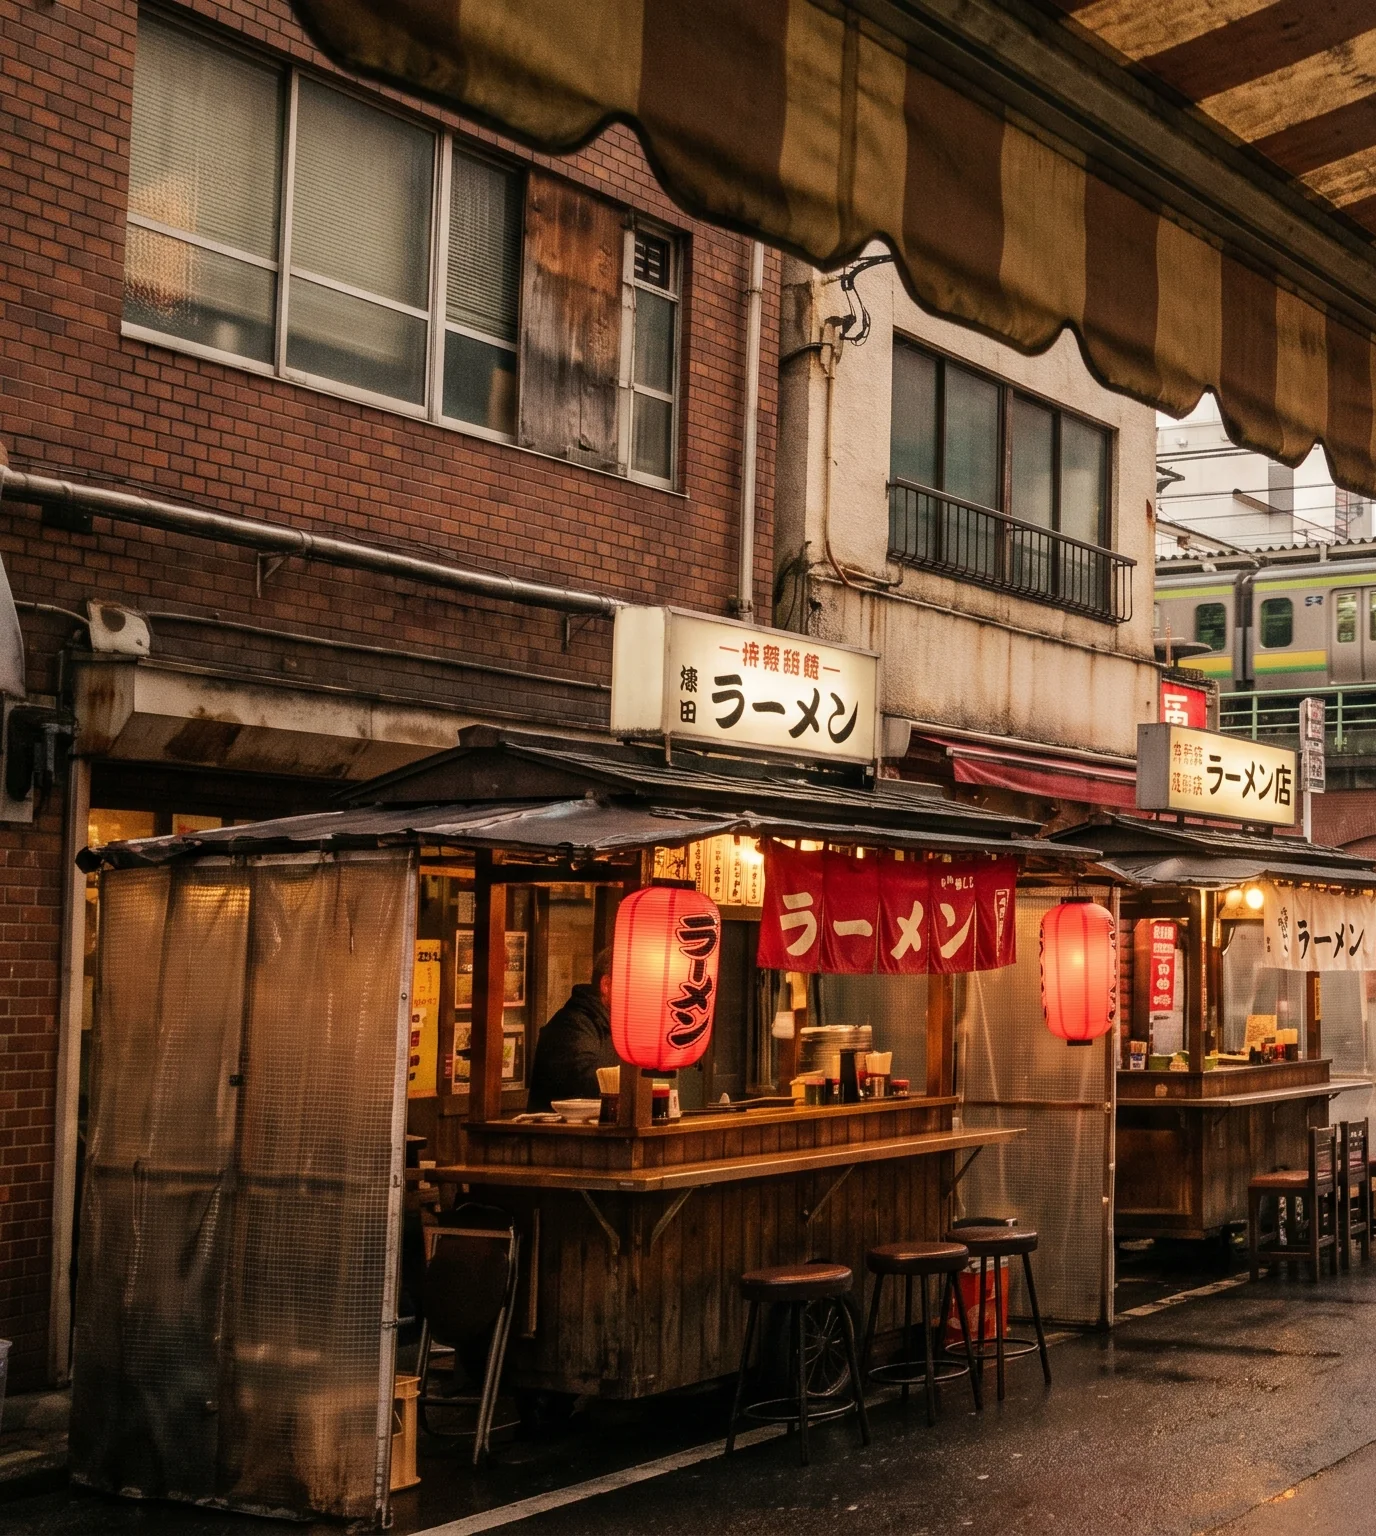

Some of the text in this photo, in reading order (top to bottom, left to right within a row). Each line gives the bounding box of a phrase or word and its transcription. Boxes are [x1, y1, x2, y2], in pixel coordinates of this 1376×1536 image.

[711, 674, 859, 743] ラーメン
[1206, 754, 1292, 806] ラーメン店
[780, 891, 975, 960] ラーメン
[1297, 919, 1365, 959] ラーメン
[668, 914, 718, 1048] ラーメン
